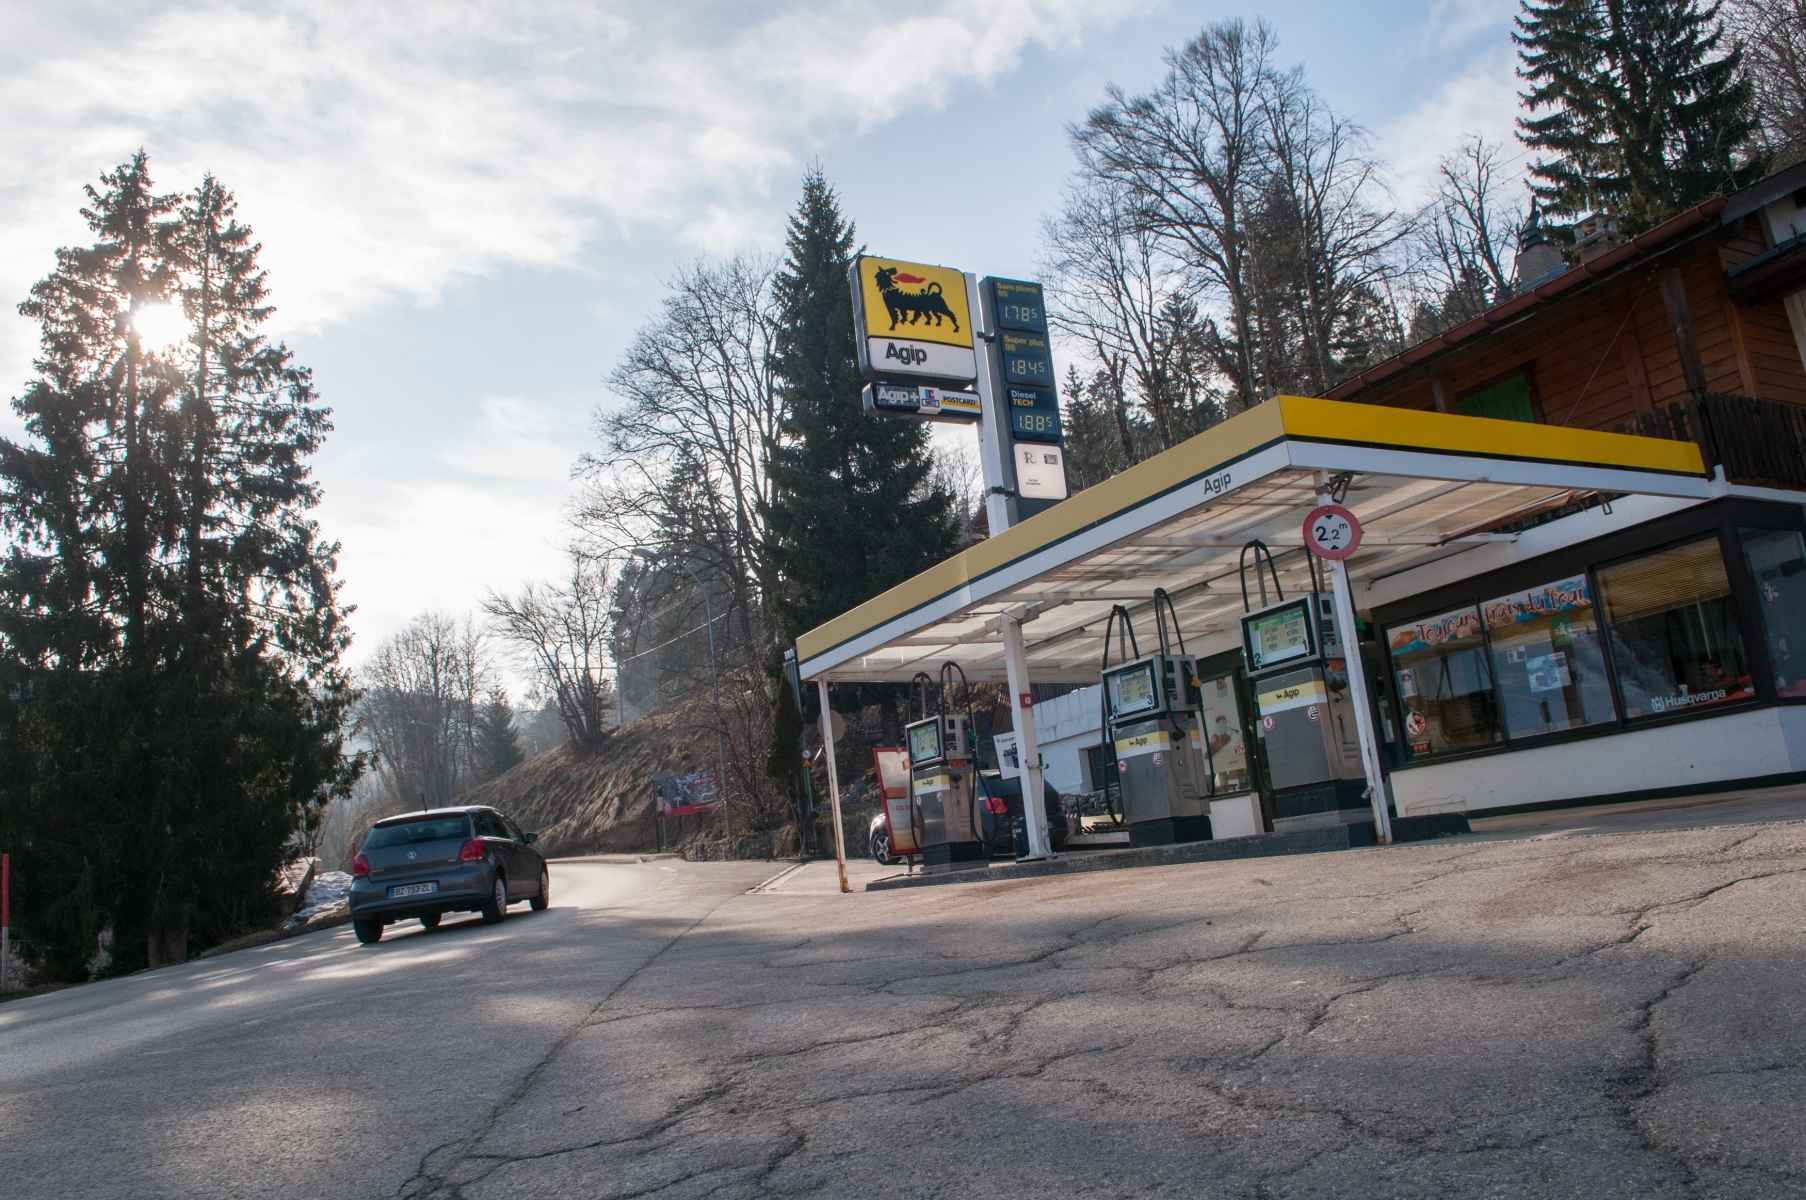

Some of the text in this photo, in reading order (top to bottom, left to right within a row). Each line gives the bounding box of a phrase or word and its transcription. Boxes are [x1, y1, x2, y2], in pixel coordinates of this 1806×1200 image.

[996, 282, 1038, 294] Sans plomb
[1004, 335, 1044, 347] Super plus
[886, 342, 928, 365] Agip
[1011, 390, 1036, 399] Diesel
[943, 396, 975, 405] POSTCARD
[1012, 398, 1034, 407] TECH
[1203, 472, 1232, 495] Agip
[1416, 585, 1586, 643] Toujours frais du four
[1254, 652, 1262, 664] 2
[1284, 688, 1300, 699] Agip
[1664, 688, 1727, 708] Husqvarna
[1147, 695, 1153, 705] 3
[1112, 704, 1118, 714] 4
[1135, 737, 1148, 747] Agip
[395, 885, 430, 896] BZ-793-ZL
